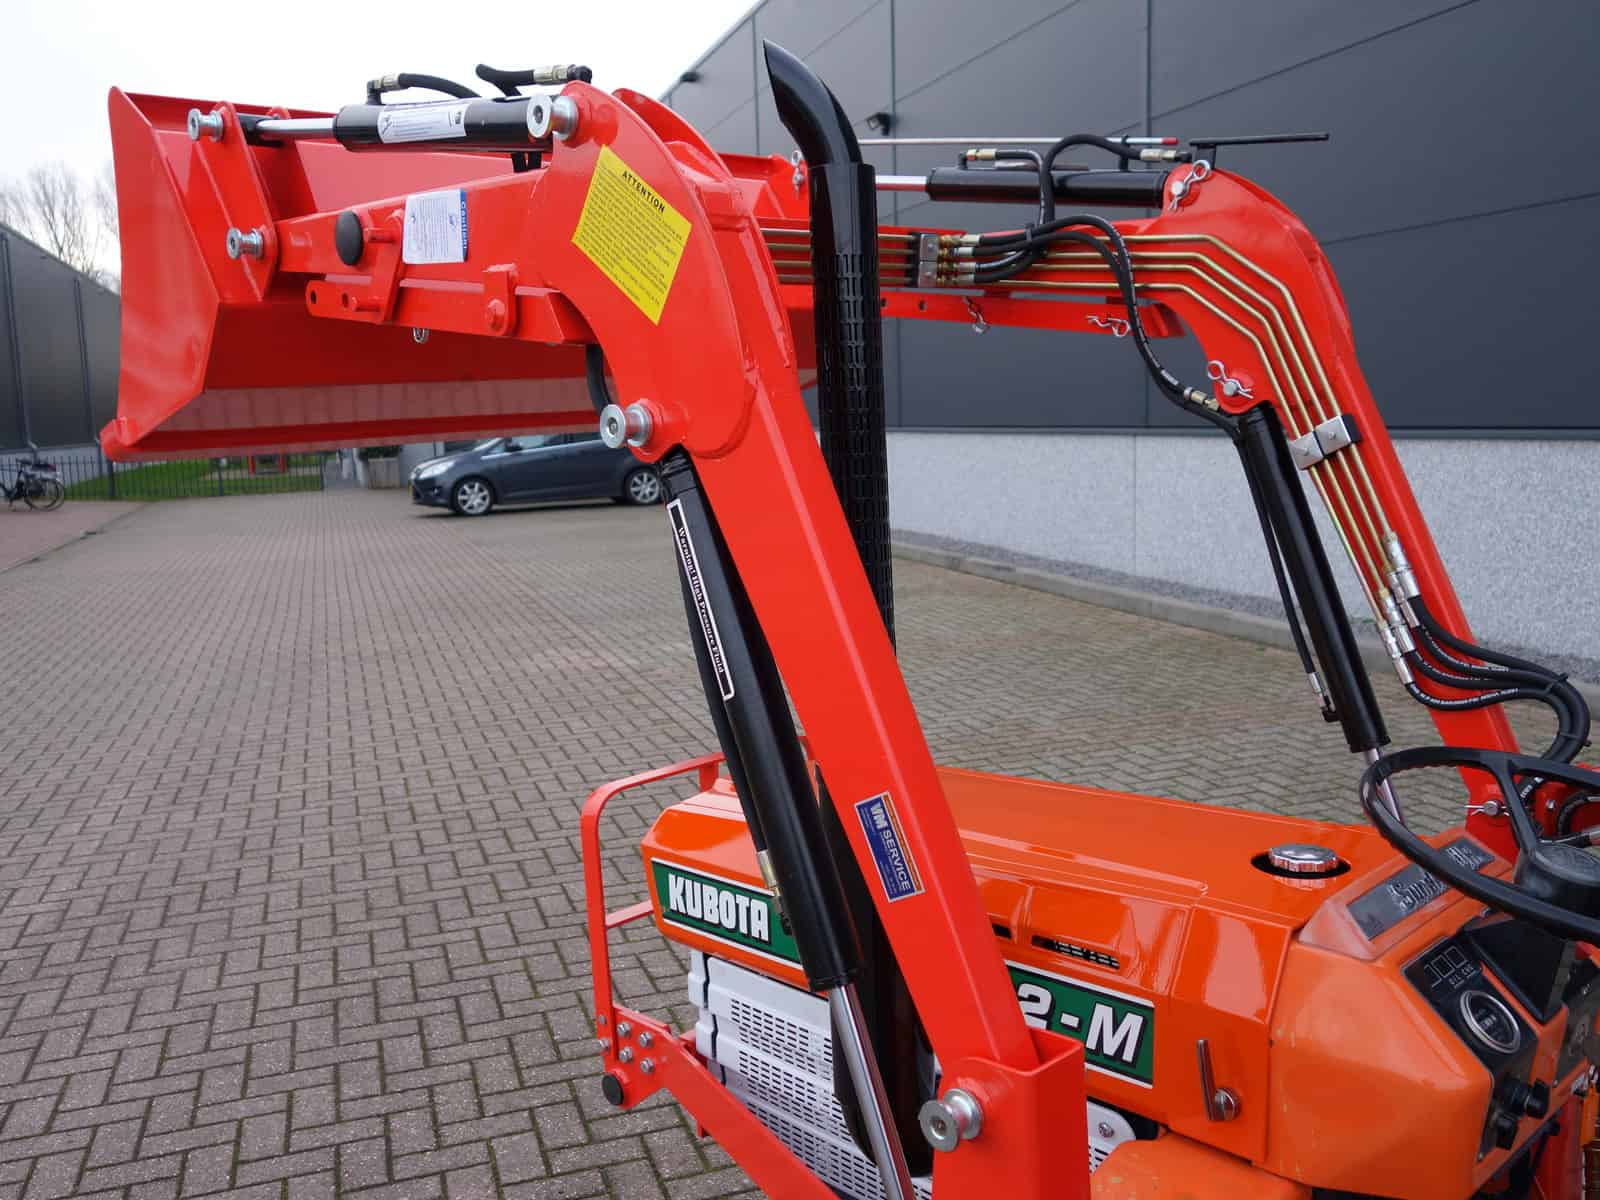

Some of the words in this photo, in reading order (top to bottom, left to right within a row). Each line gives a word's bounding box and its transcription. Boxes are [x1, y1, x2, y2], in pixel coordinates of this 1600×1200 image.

[622, 171, 665, 213] ATTENTION
[700, 601, 715, 645] Pressure
[712, 646, 724, 673] Fluid
[881, 829, 911, 892] SERVICE
[668, 873, 770, 942] KUBOTA
